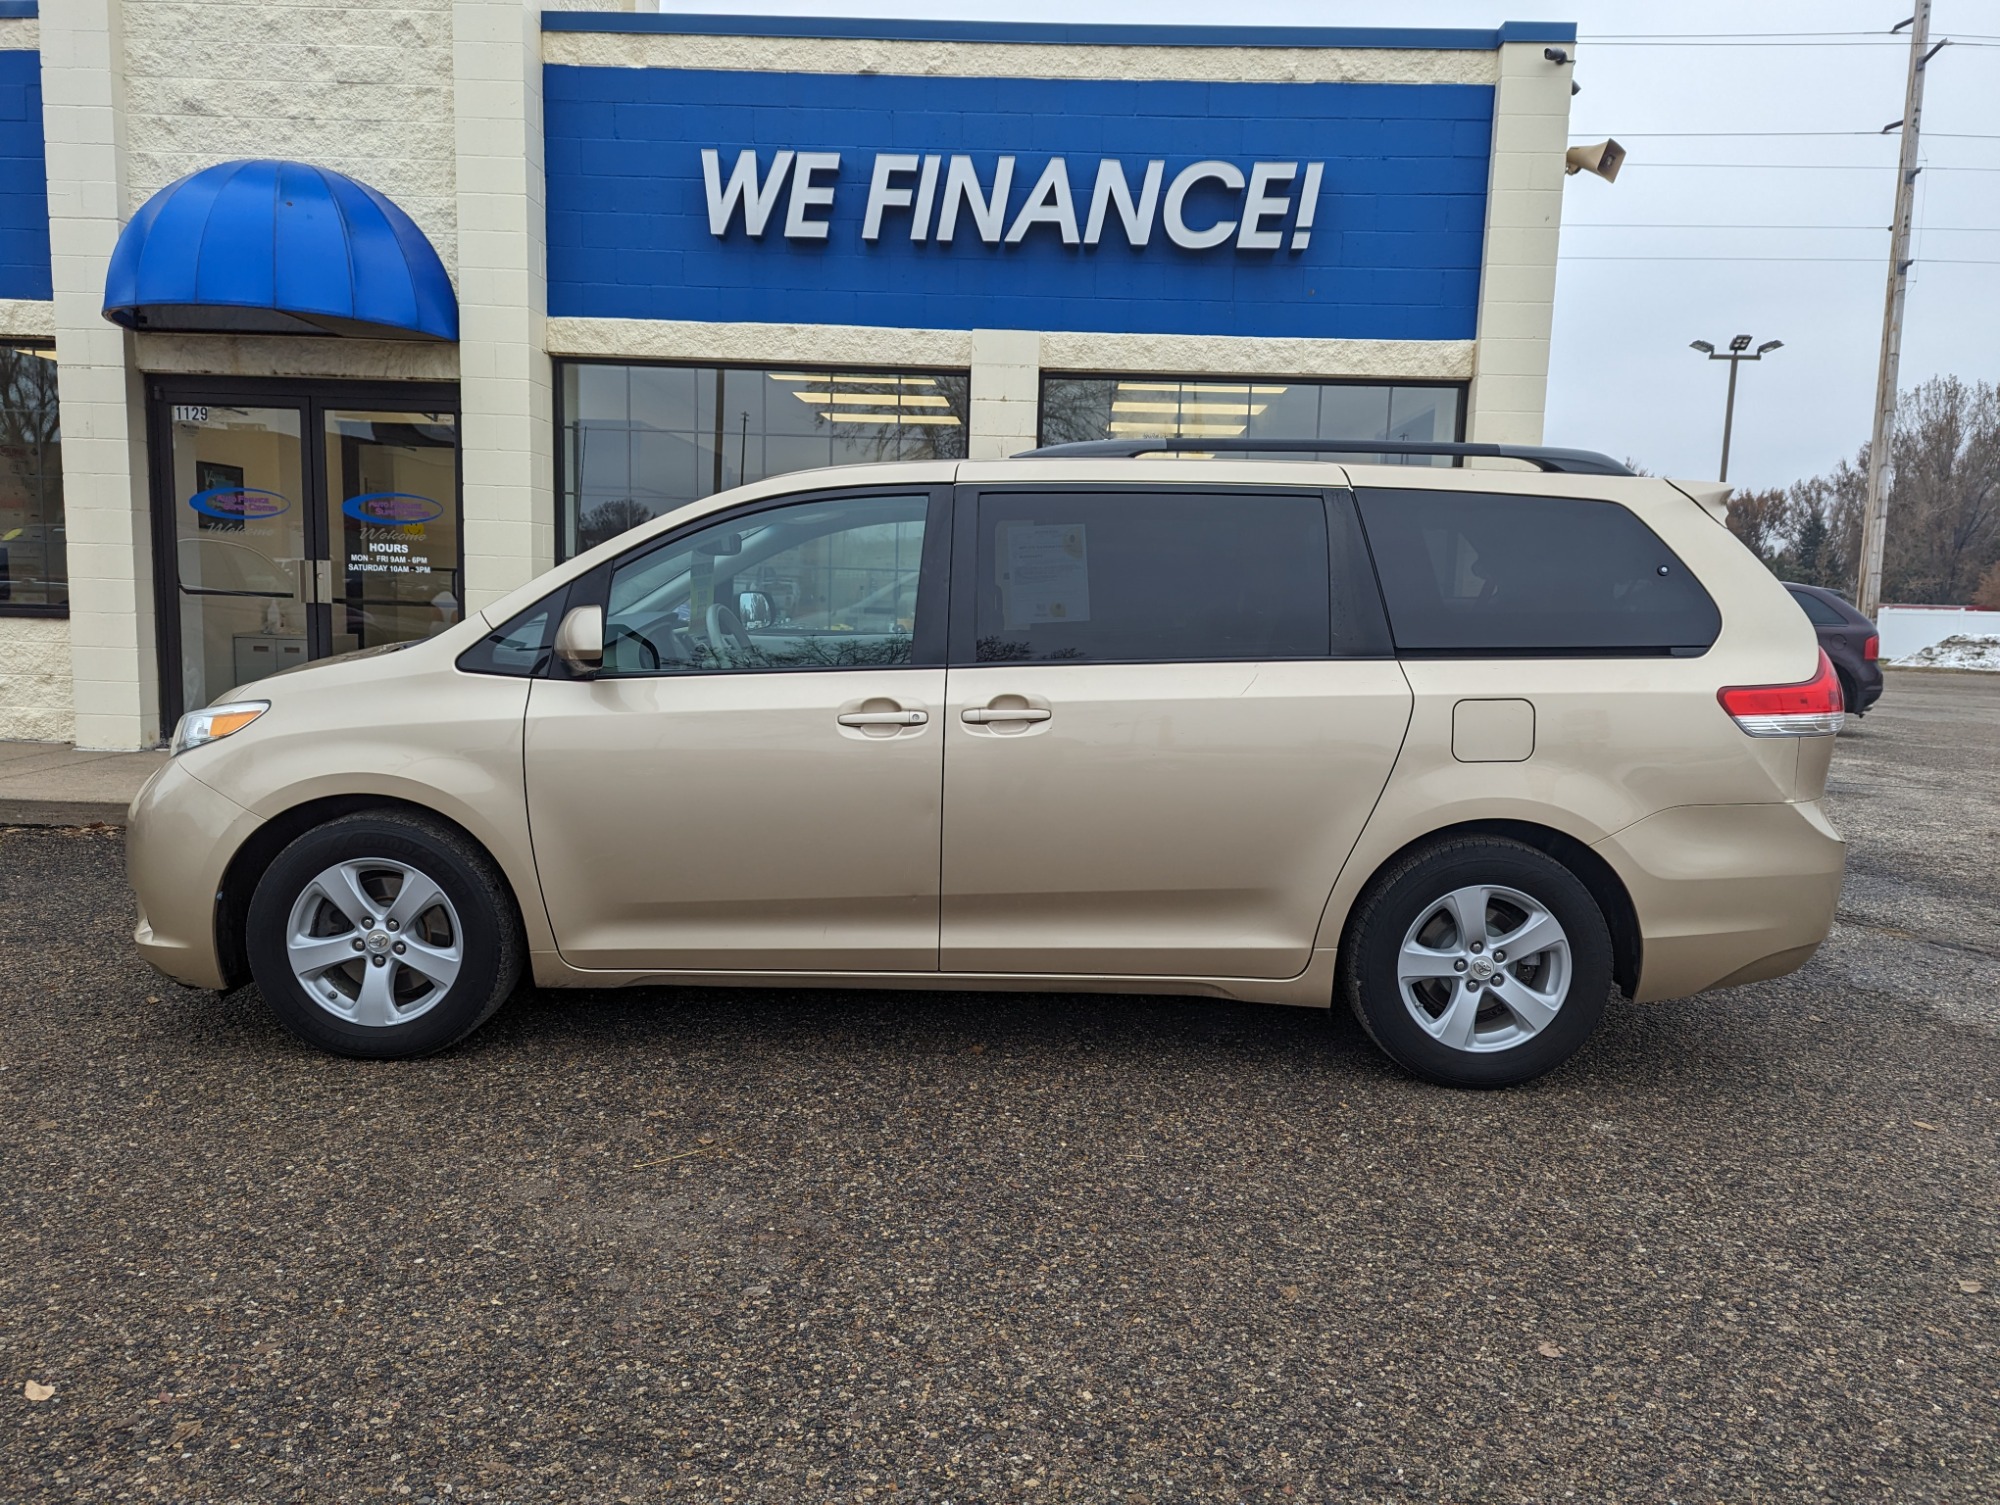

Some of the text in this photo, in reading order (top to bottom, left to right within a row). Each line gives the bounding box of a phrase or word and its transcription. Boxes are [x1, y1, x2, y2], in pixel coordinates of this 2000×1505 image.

[701, 149, 1325, 250] WE FINANCE!
[176, 406, 208, 421] 1129
[360, 527, 427, 541] Welcome
[369, 543, 409, 553] HOURS
[351, 554, 369, 562] MON
[376, 555, 389, 563] FRI
[412, 556, 428, 564] 6PM
[348, 563, 388, 572] SATURDAY
[390, 565, 409, 573] 10AM
[415, 566, 431, 574] 3PM
